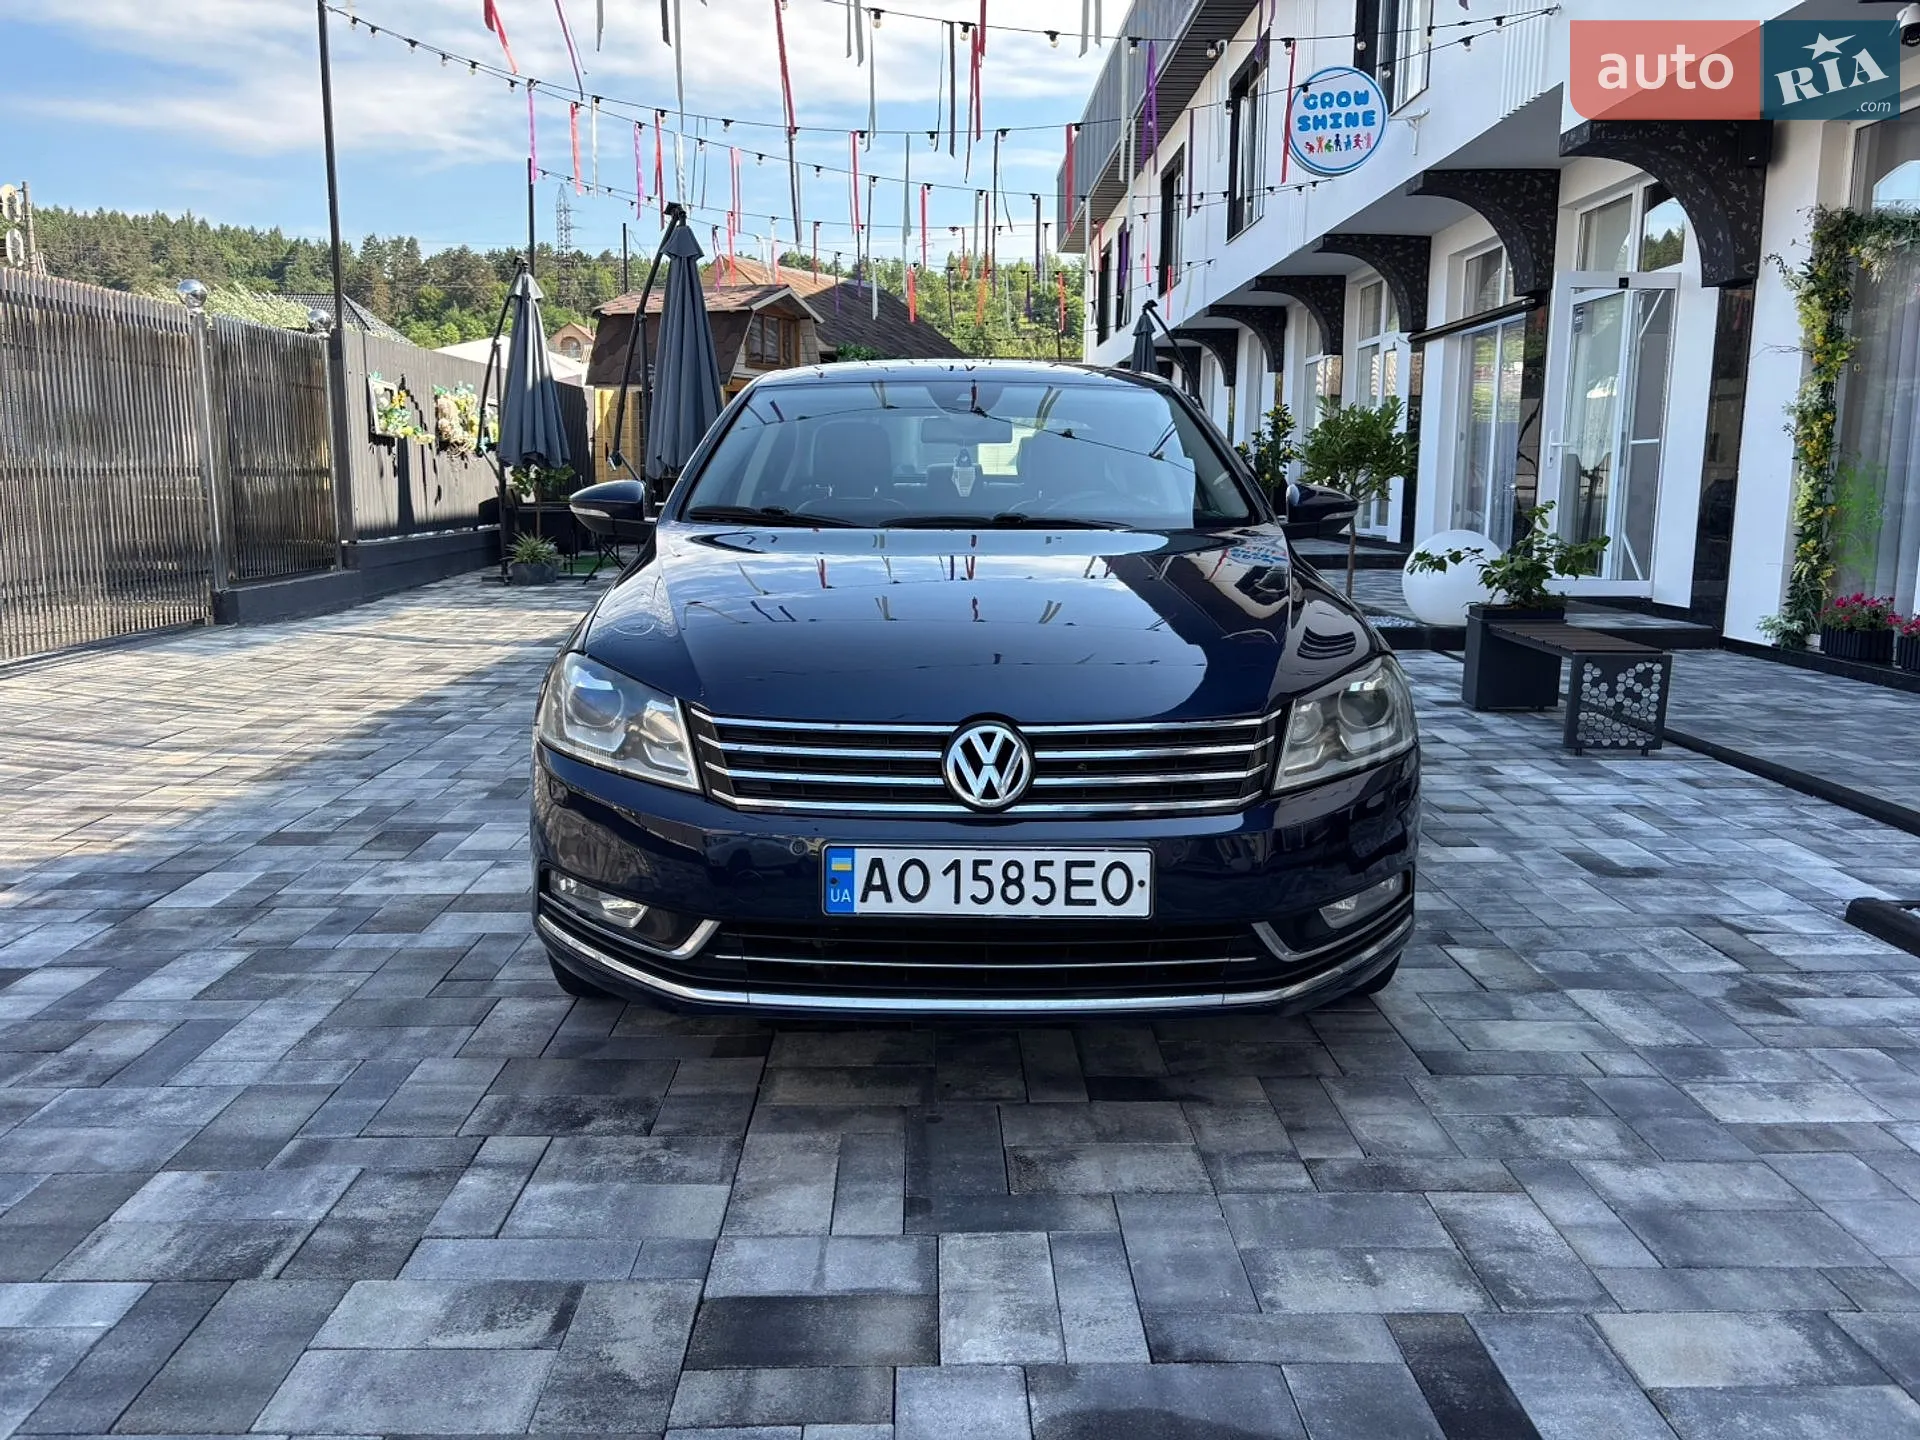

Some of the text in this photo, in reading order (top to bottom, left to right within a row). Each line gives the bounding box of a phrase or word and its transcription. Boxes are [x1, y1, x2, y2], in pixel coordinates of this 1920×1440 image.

[1303, 90, 1369, 110] GROW
[1297, 110, 1376, 131] SHINE
[831, 888, 851, 904] UA
